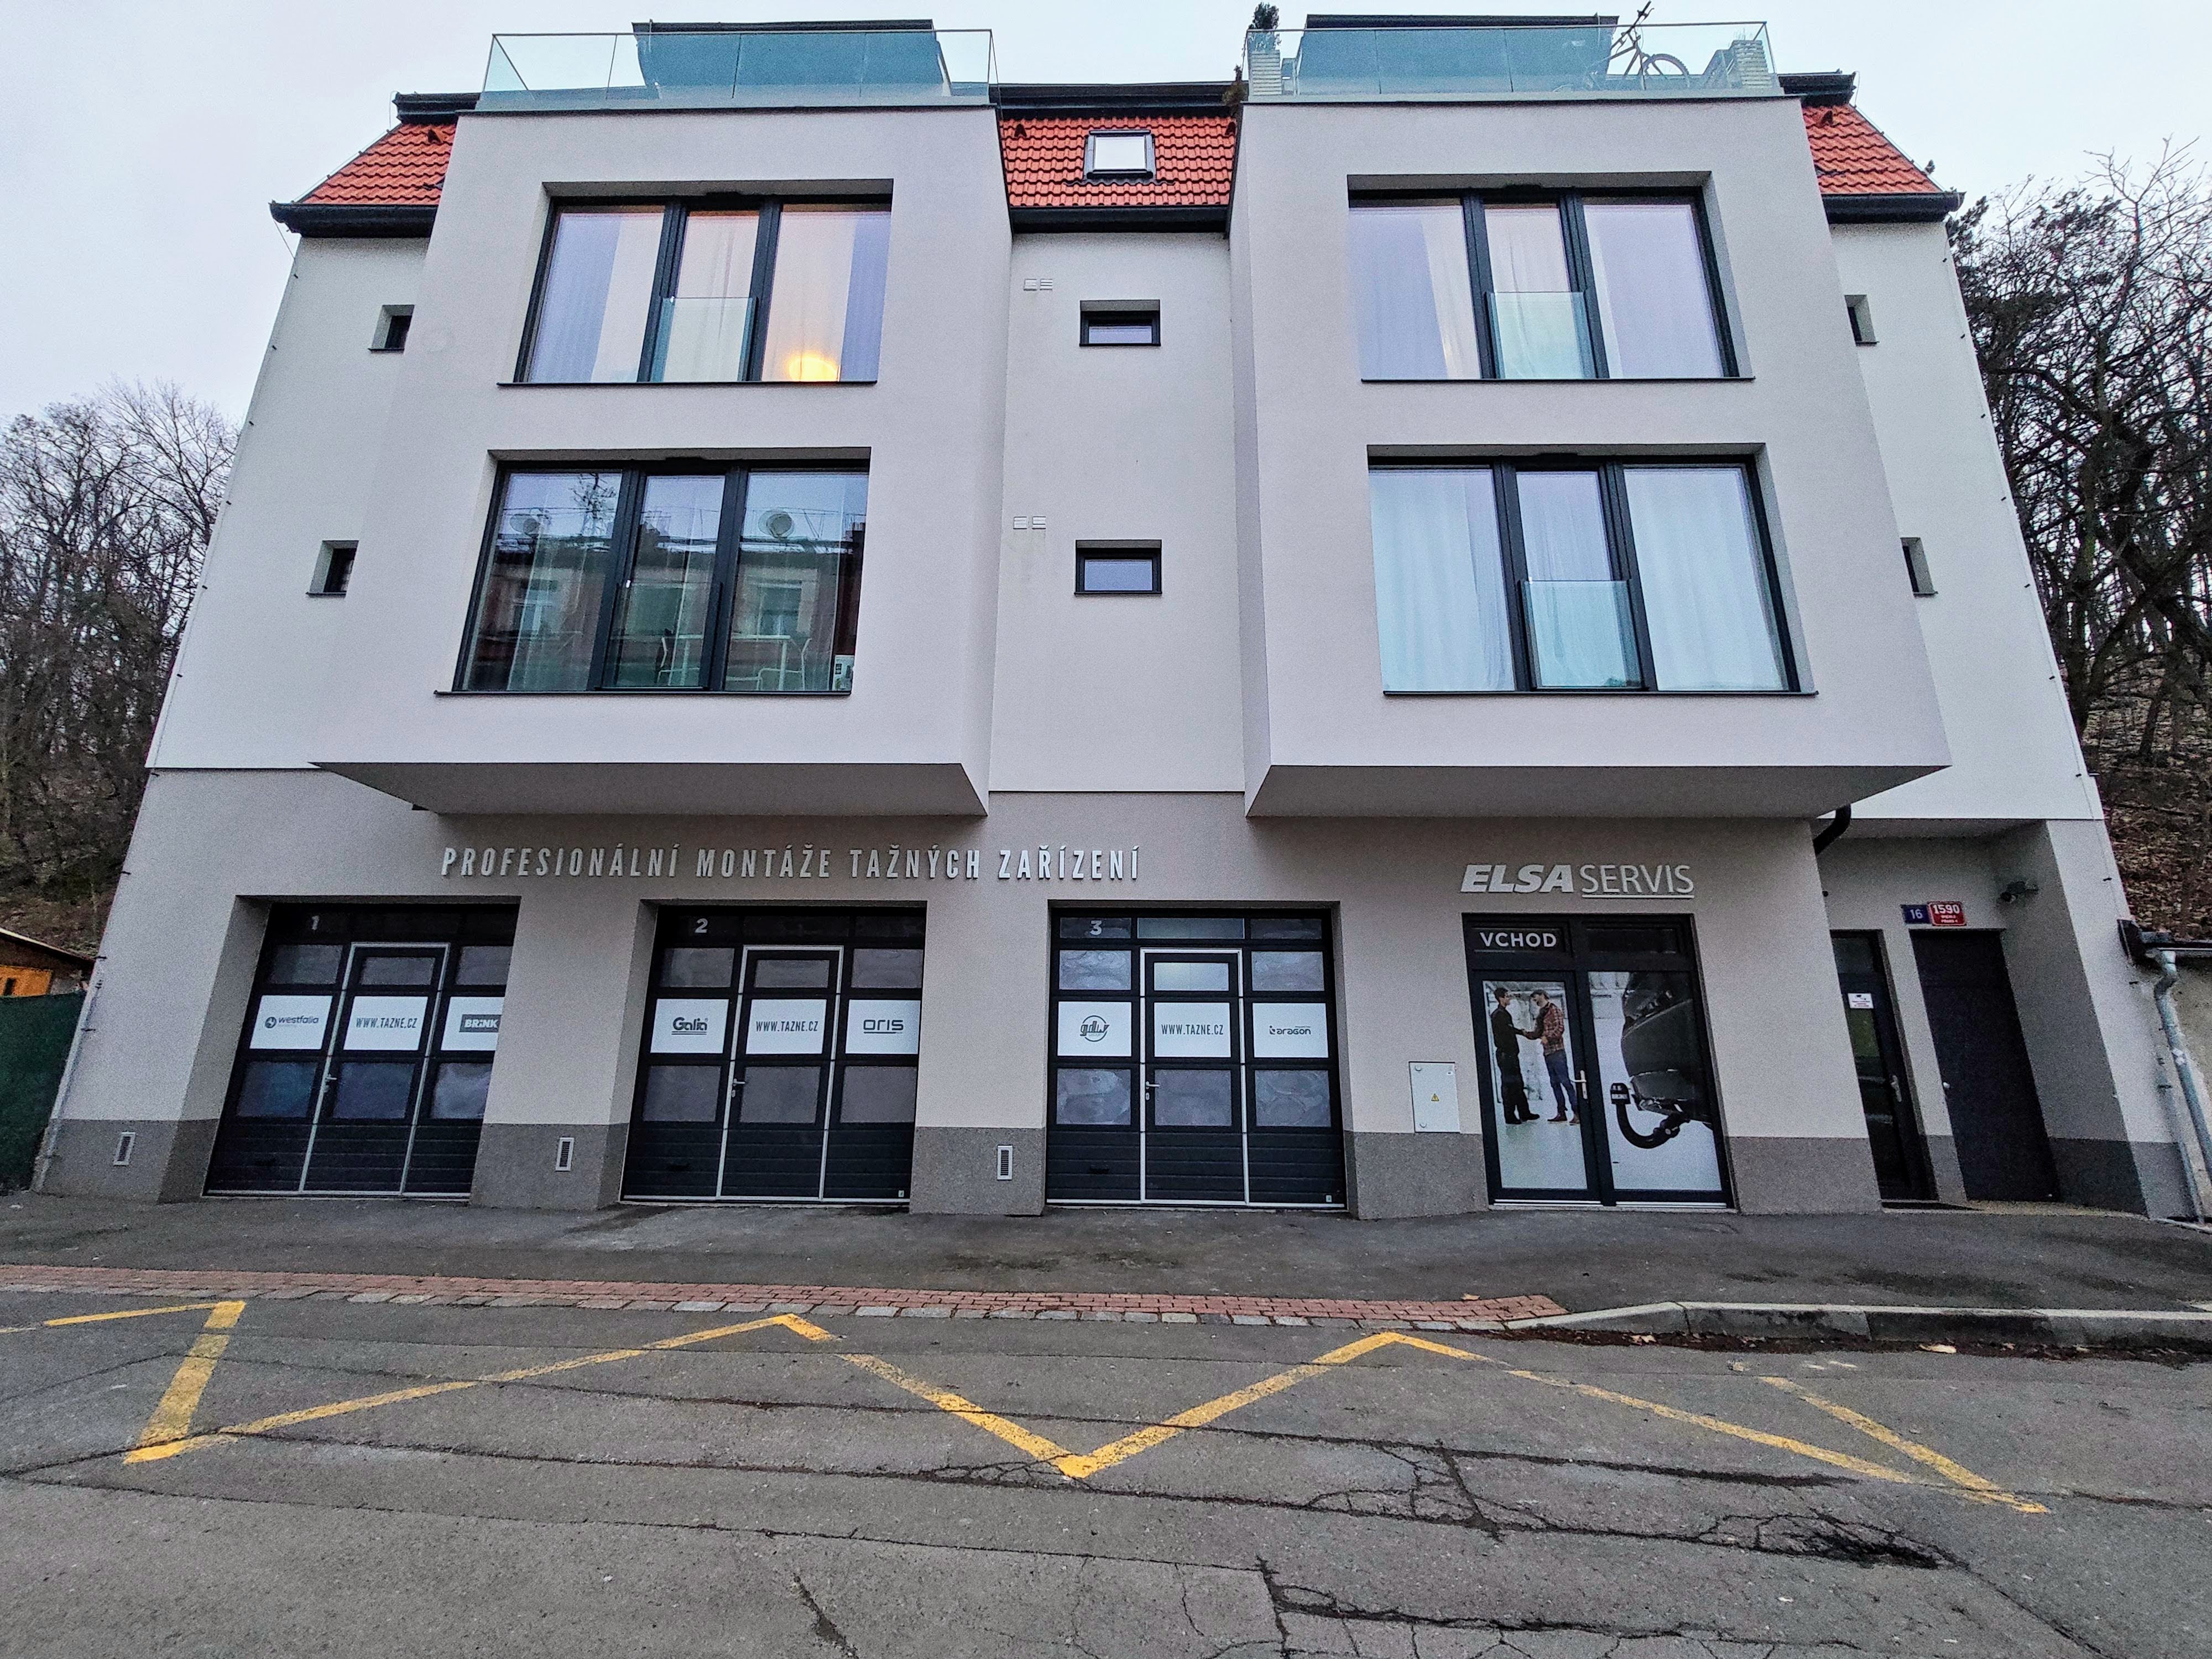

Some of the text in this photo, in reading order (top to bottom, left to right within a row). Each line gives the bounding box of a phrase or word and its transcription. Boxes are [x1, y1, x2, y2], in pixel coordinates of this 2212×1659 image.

[441, 843, 1139, 879] PROFESIONÁLNÍ MONTÁŽE TAŽNÝCH ZAŘÍZENÍ
[1460, 864, 1694, 894] ELSA SERVIS
[1910, 909, 1923, 919] 16
[1933, 904, 1960, 914] 1590
[311, 915, 319, 930] 1
[695, 919, 708, 933] 2
[1089, 920, 1103, 936] 3
[1480, 932, 1557, 947] VCHOD
[356, 1018, 418, 1029] WWW.TAZNE.CZ
[756, 1021, 818, 1032] WWW.TAZNE.CZ
[1161, 1024, 1223, 1035] WWW.TAZNE.CZ
